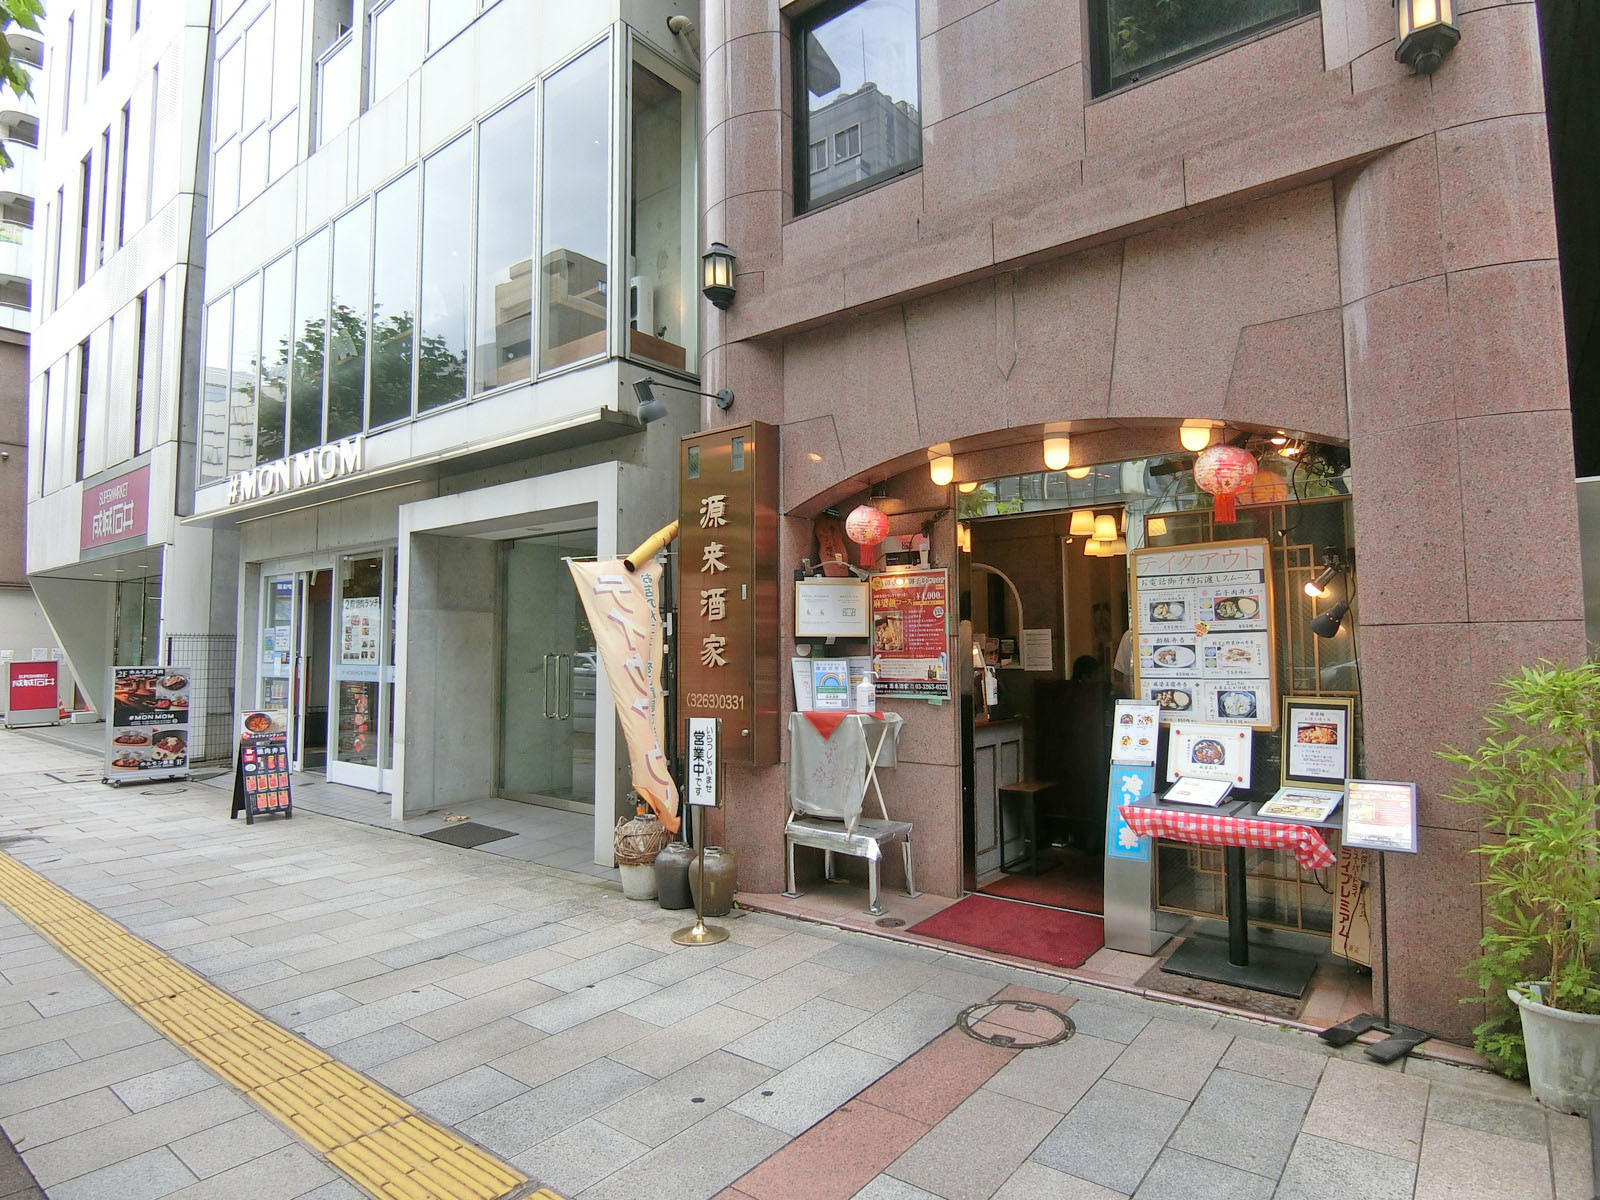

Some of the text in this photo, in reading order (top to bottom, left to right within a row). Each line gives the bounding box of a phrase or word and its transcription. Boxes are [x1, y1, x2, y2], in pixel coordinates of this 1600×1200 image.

[99, 482, 129, 506] SUPERMARKET
[93, 500, 135, 540] 成城石井
[1138, 549, 1258, 574] テイクアウト
[699, 494, 731, 668] 源来酒家
[686, 692, 744, 710] (3263)0331
